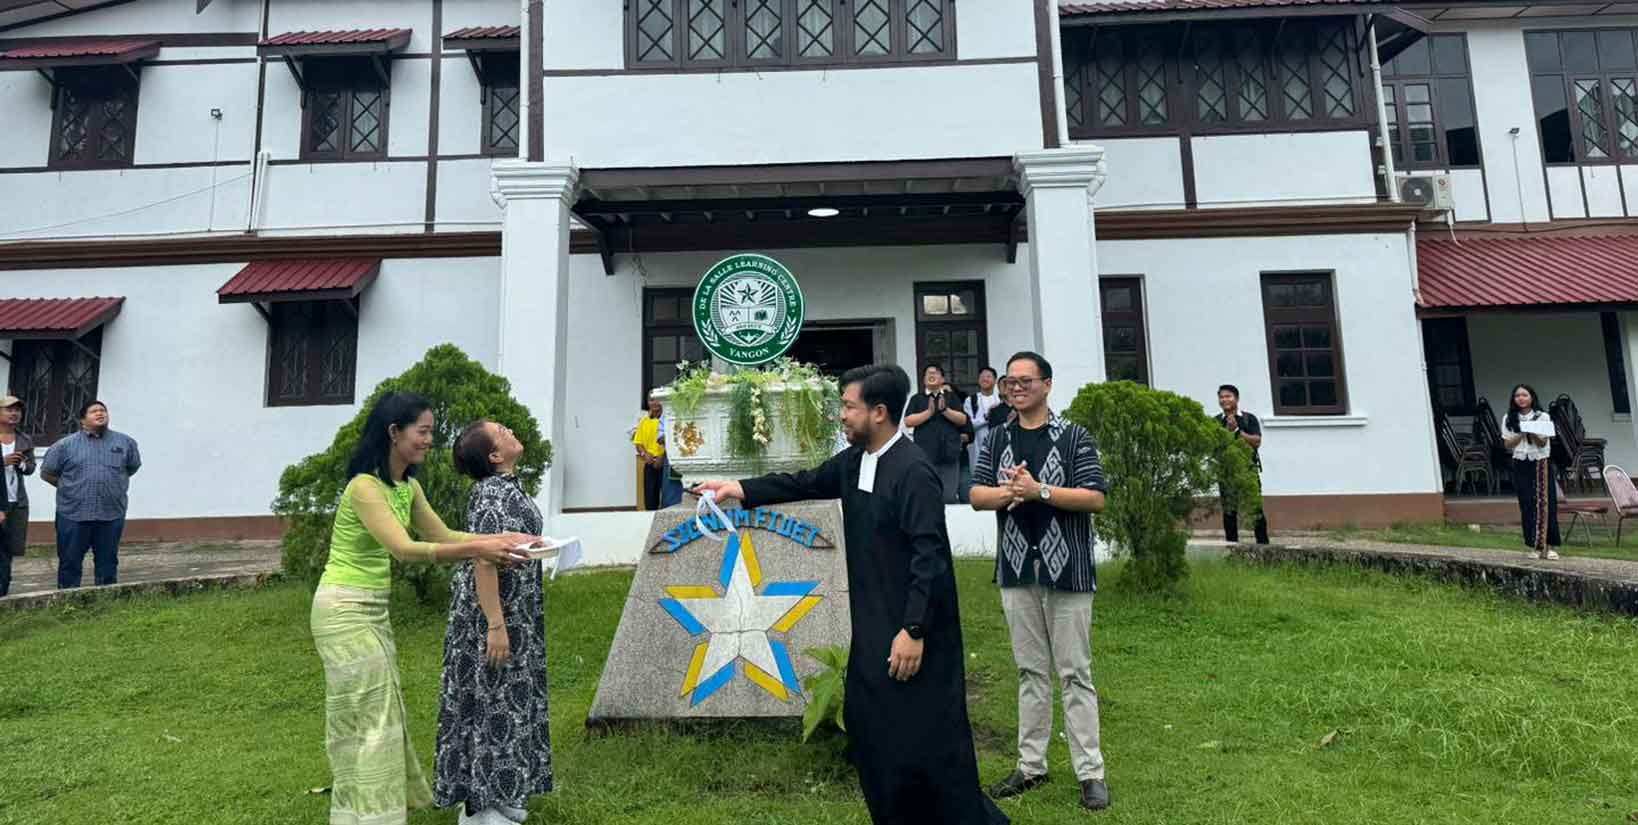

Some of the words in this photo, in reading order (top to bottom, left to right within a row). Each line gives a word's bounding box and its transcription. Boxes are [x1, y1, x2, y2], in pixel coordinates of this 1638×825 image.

[699, 297, 707, 310] DE
[703, 285, 713, 296] LA
[709, 264, 734, 284] SALLE
[734, 260, 778, 276] LEARNING
[778, 275, 797, 307] CENTRE
[729, 346, 770, 359] YANGON
